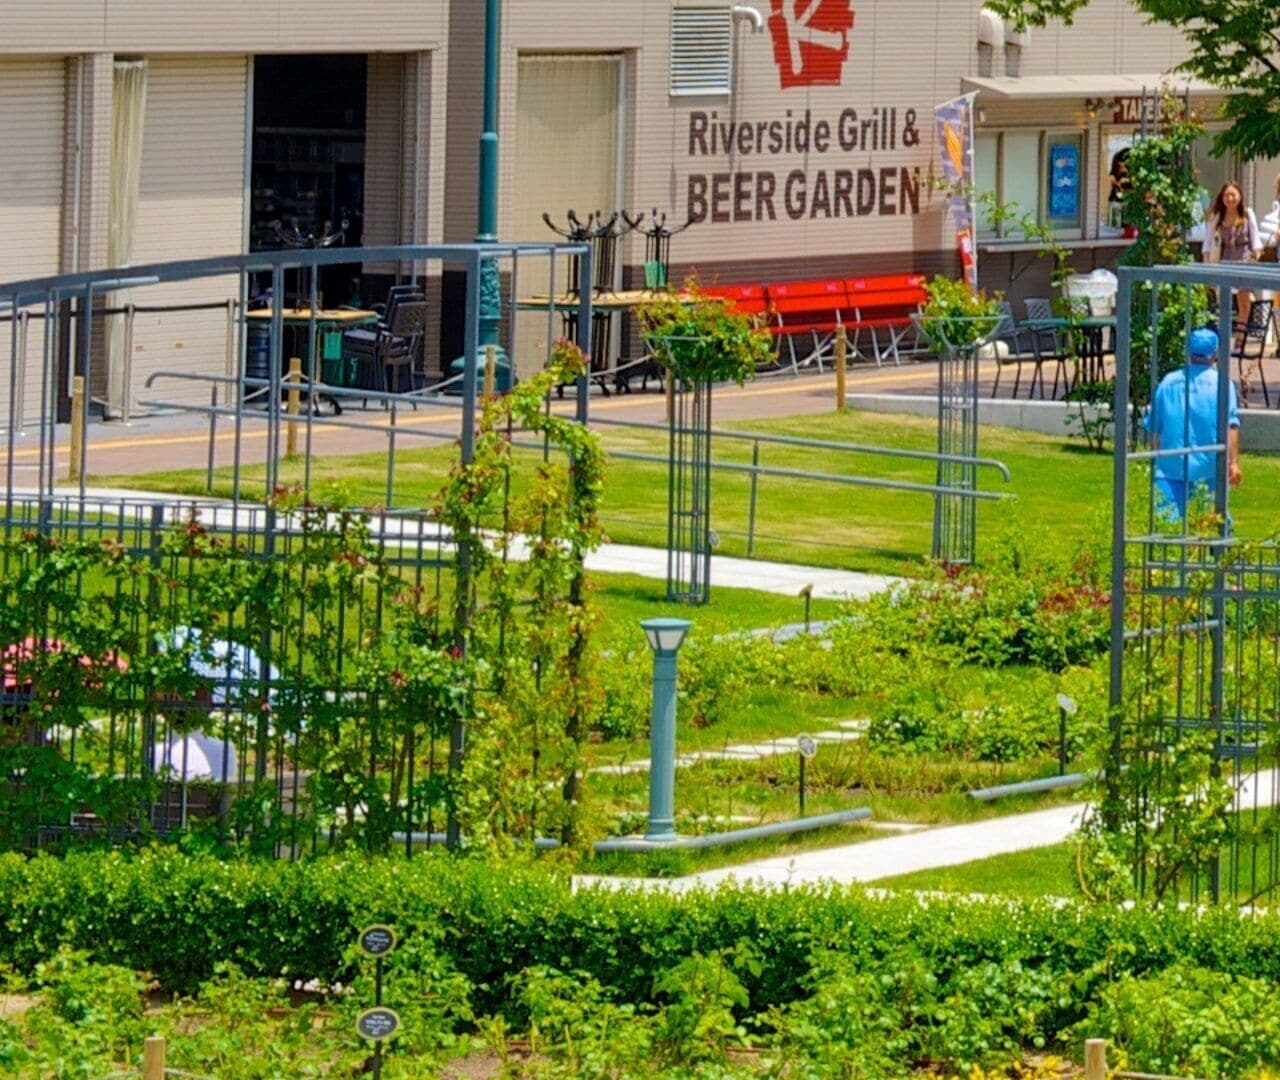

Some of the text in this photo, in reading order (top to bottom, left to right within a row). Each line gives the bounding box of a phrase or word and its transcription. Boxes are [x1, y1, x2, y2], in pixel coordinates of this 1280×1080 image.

[688, 107, 920, 156] Riverside Grill &
[687, 167, 920, 223] BEER GARDEN
